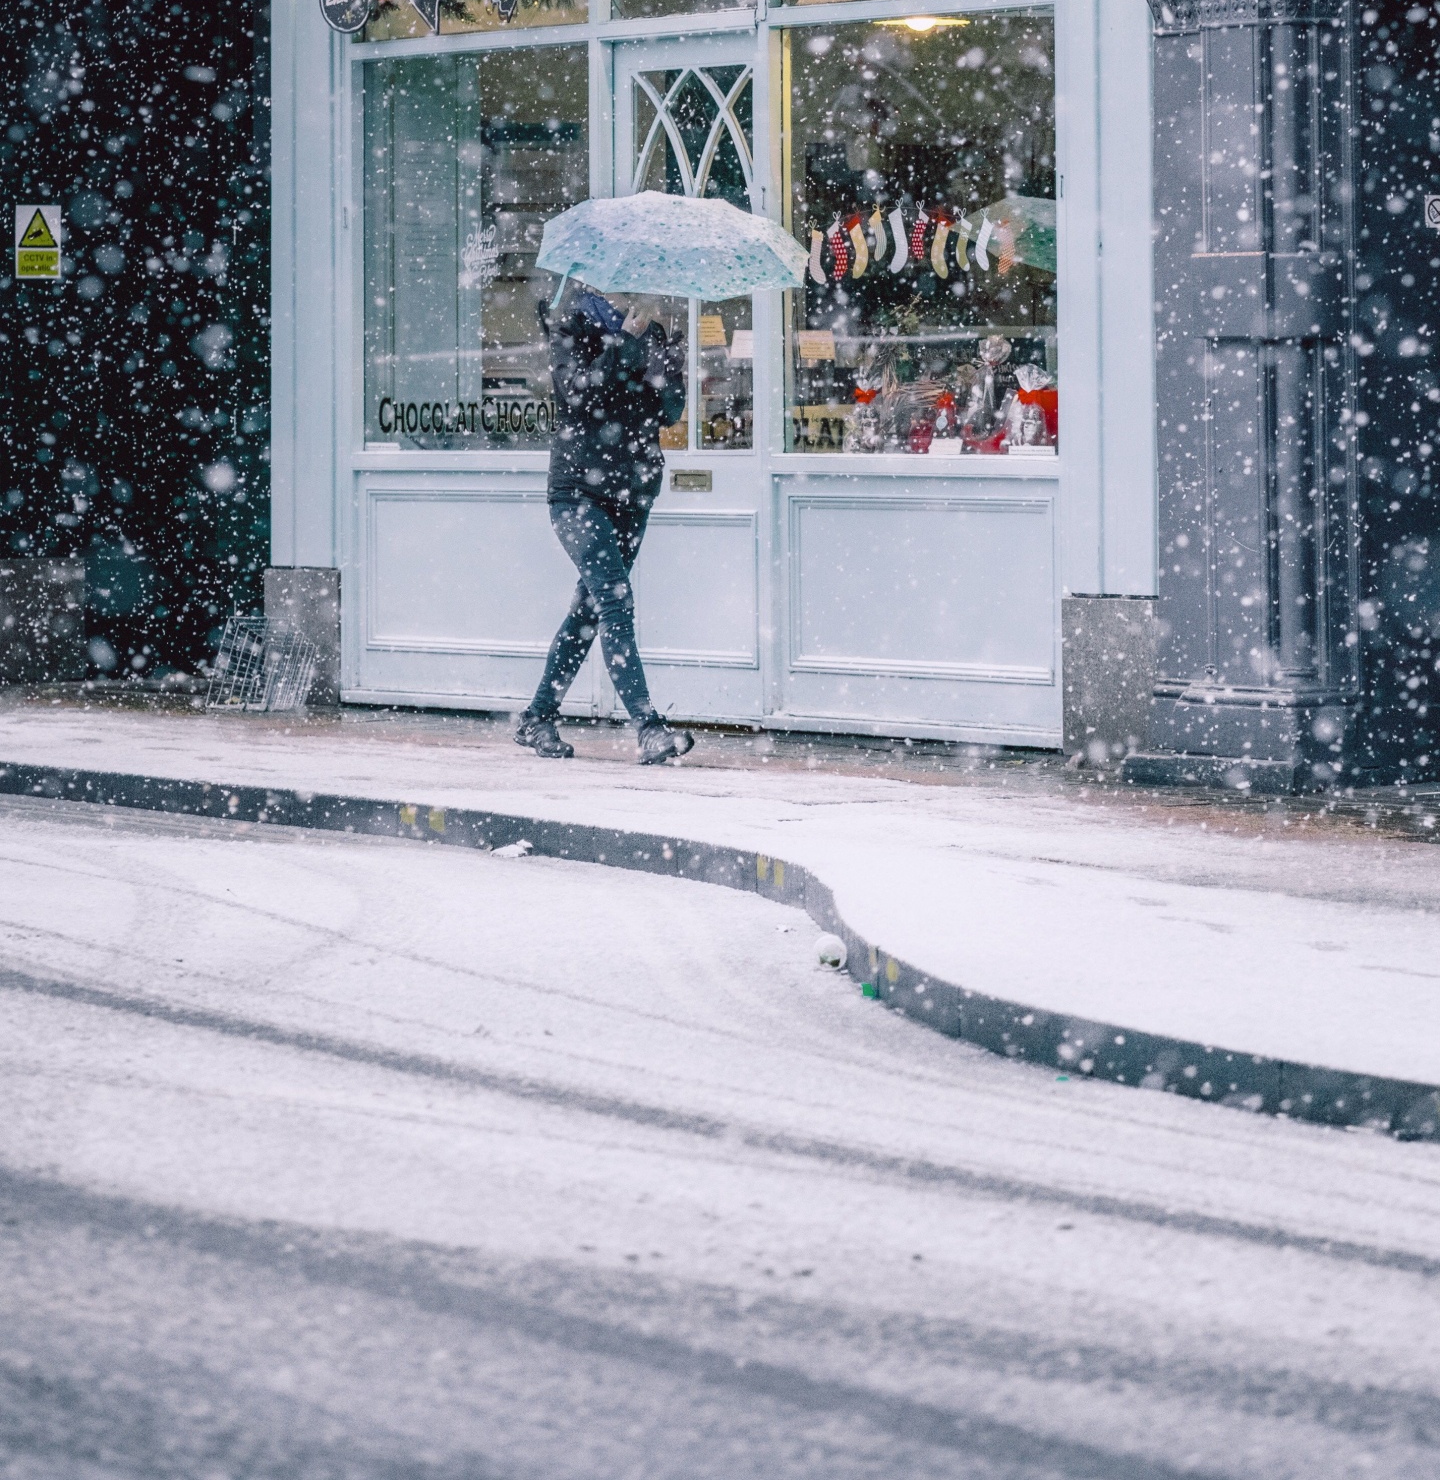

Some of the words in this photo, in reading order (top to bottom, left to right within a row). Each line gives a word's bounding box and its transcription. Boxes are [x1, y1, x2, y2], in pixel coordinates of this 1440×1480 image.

[24, 254, 44, 262] CCTV
[46, 254, 53, 262] in
[379, 397, 479, 434] CHOCOLAT
